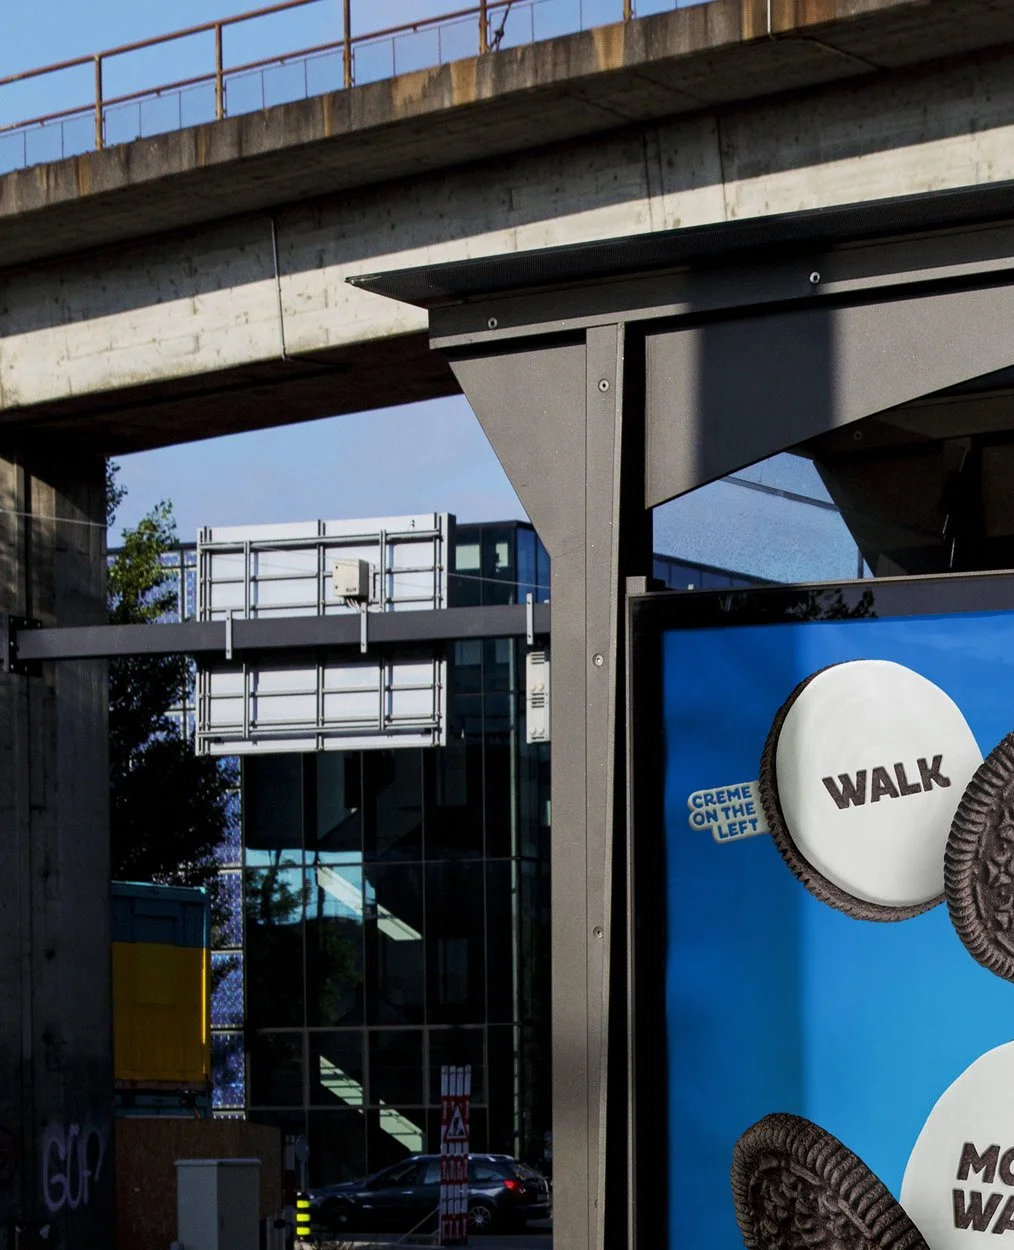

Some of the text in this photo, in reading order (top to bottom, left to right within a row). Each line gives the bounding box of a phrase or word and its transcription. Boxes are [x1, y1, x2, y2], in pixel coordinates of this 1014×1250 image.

[822, 754, 951, 809] WALK
[692, 785, 752, 808] CREME
[693, 802, 756, 826] ON THE
[717, 818, 758, 839] LEFT
